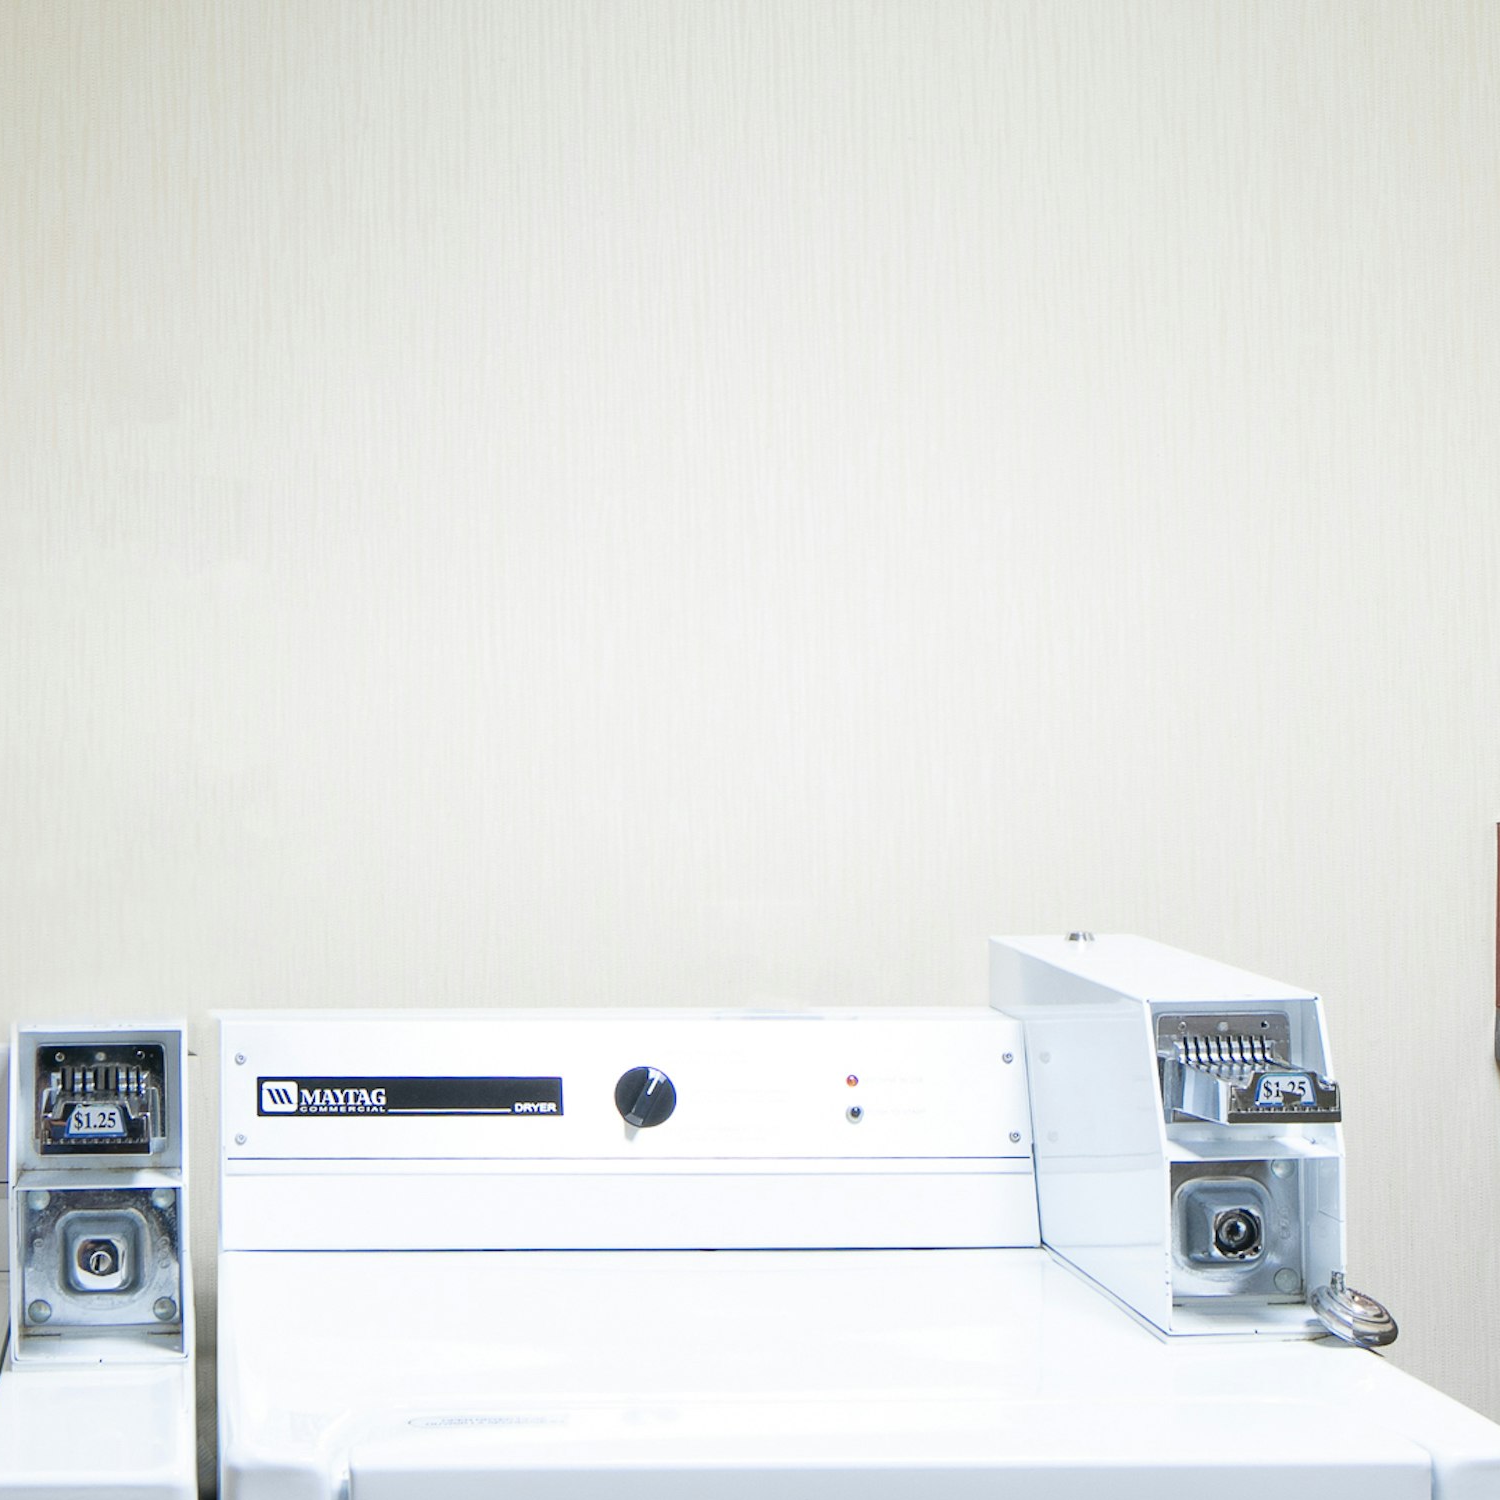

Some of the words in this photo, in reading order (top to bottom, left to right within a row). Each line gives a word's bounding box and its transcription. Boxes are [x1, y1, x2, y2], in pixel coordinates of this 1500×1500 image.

[300, 1088, 386, 1105] MAYTAG
[1263, 1080, 1306, 1099] $125
[514, 1102, 557, 1113] DRYER
[74, 1110, 116, 1131] $1.25
